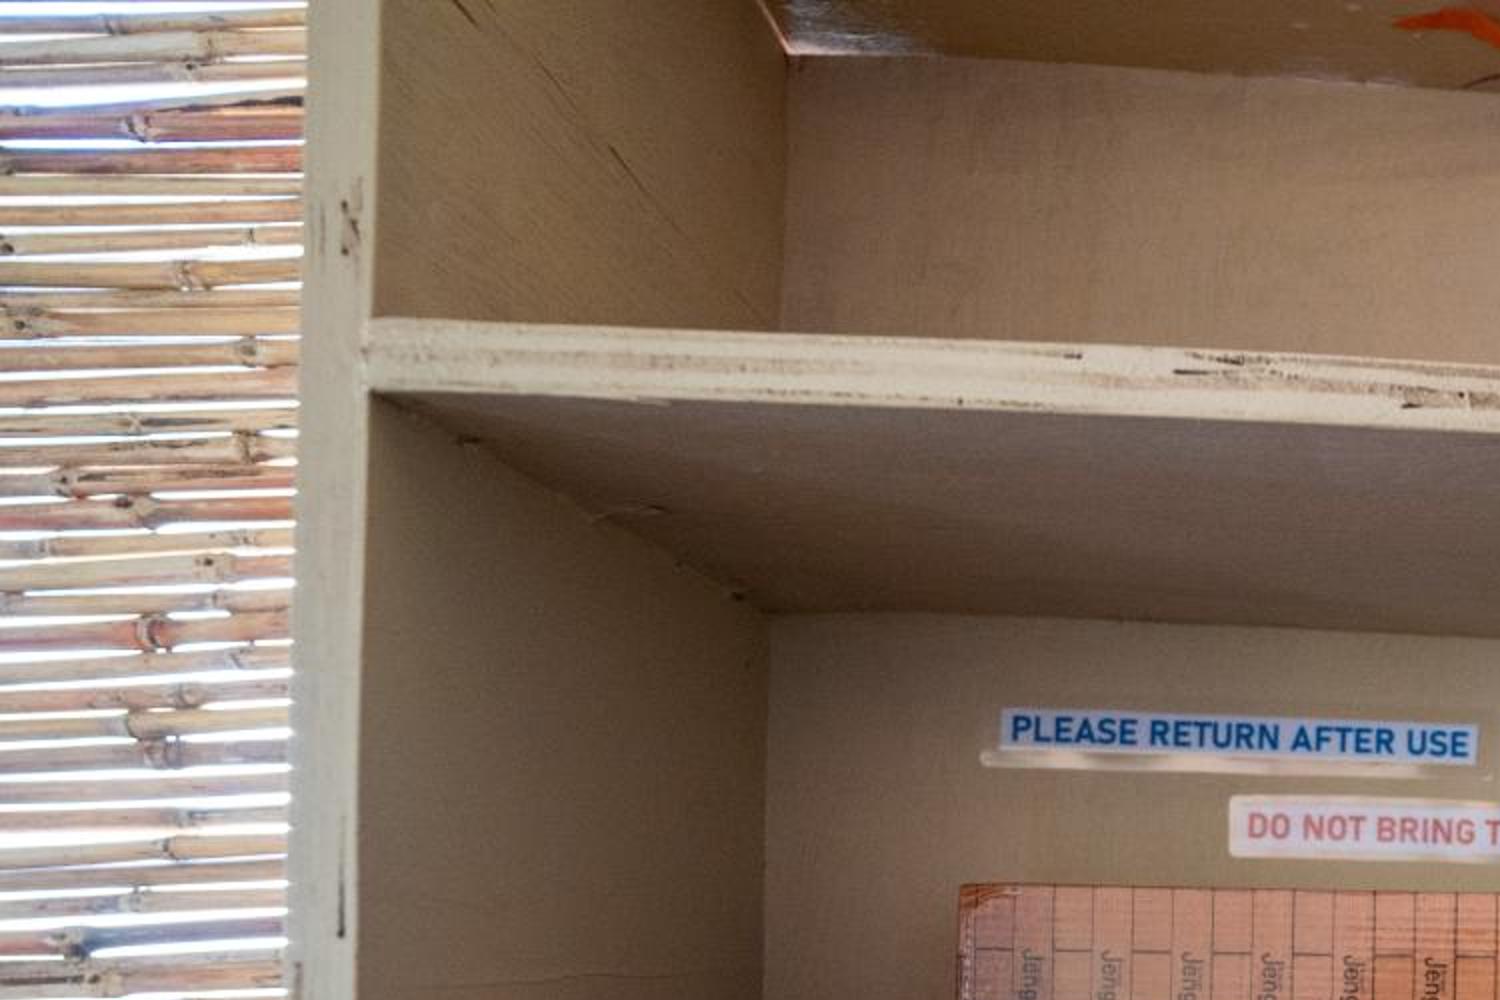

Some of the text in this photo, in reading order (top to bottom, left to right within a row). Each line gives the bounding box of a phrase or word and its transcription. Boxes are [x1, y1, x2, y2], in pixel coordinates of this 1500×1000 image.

[1011, 714, 1470, 758] PLEASE RETURN AFTER USE
[1247, 812, 1291, 840] DO
[1302, 814, 1367, 842] NOT
[1376, 816, 1477, 846] BRING
